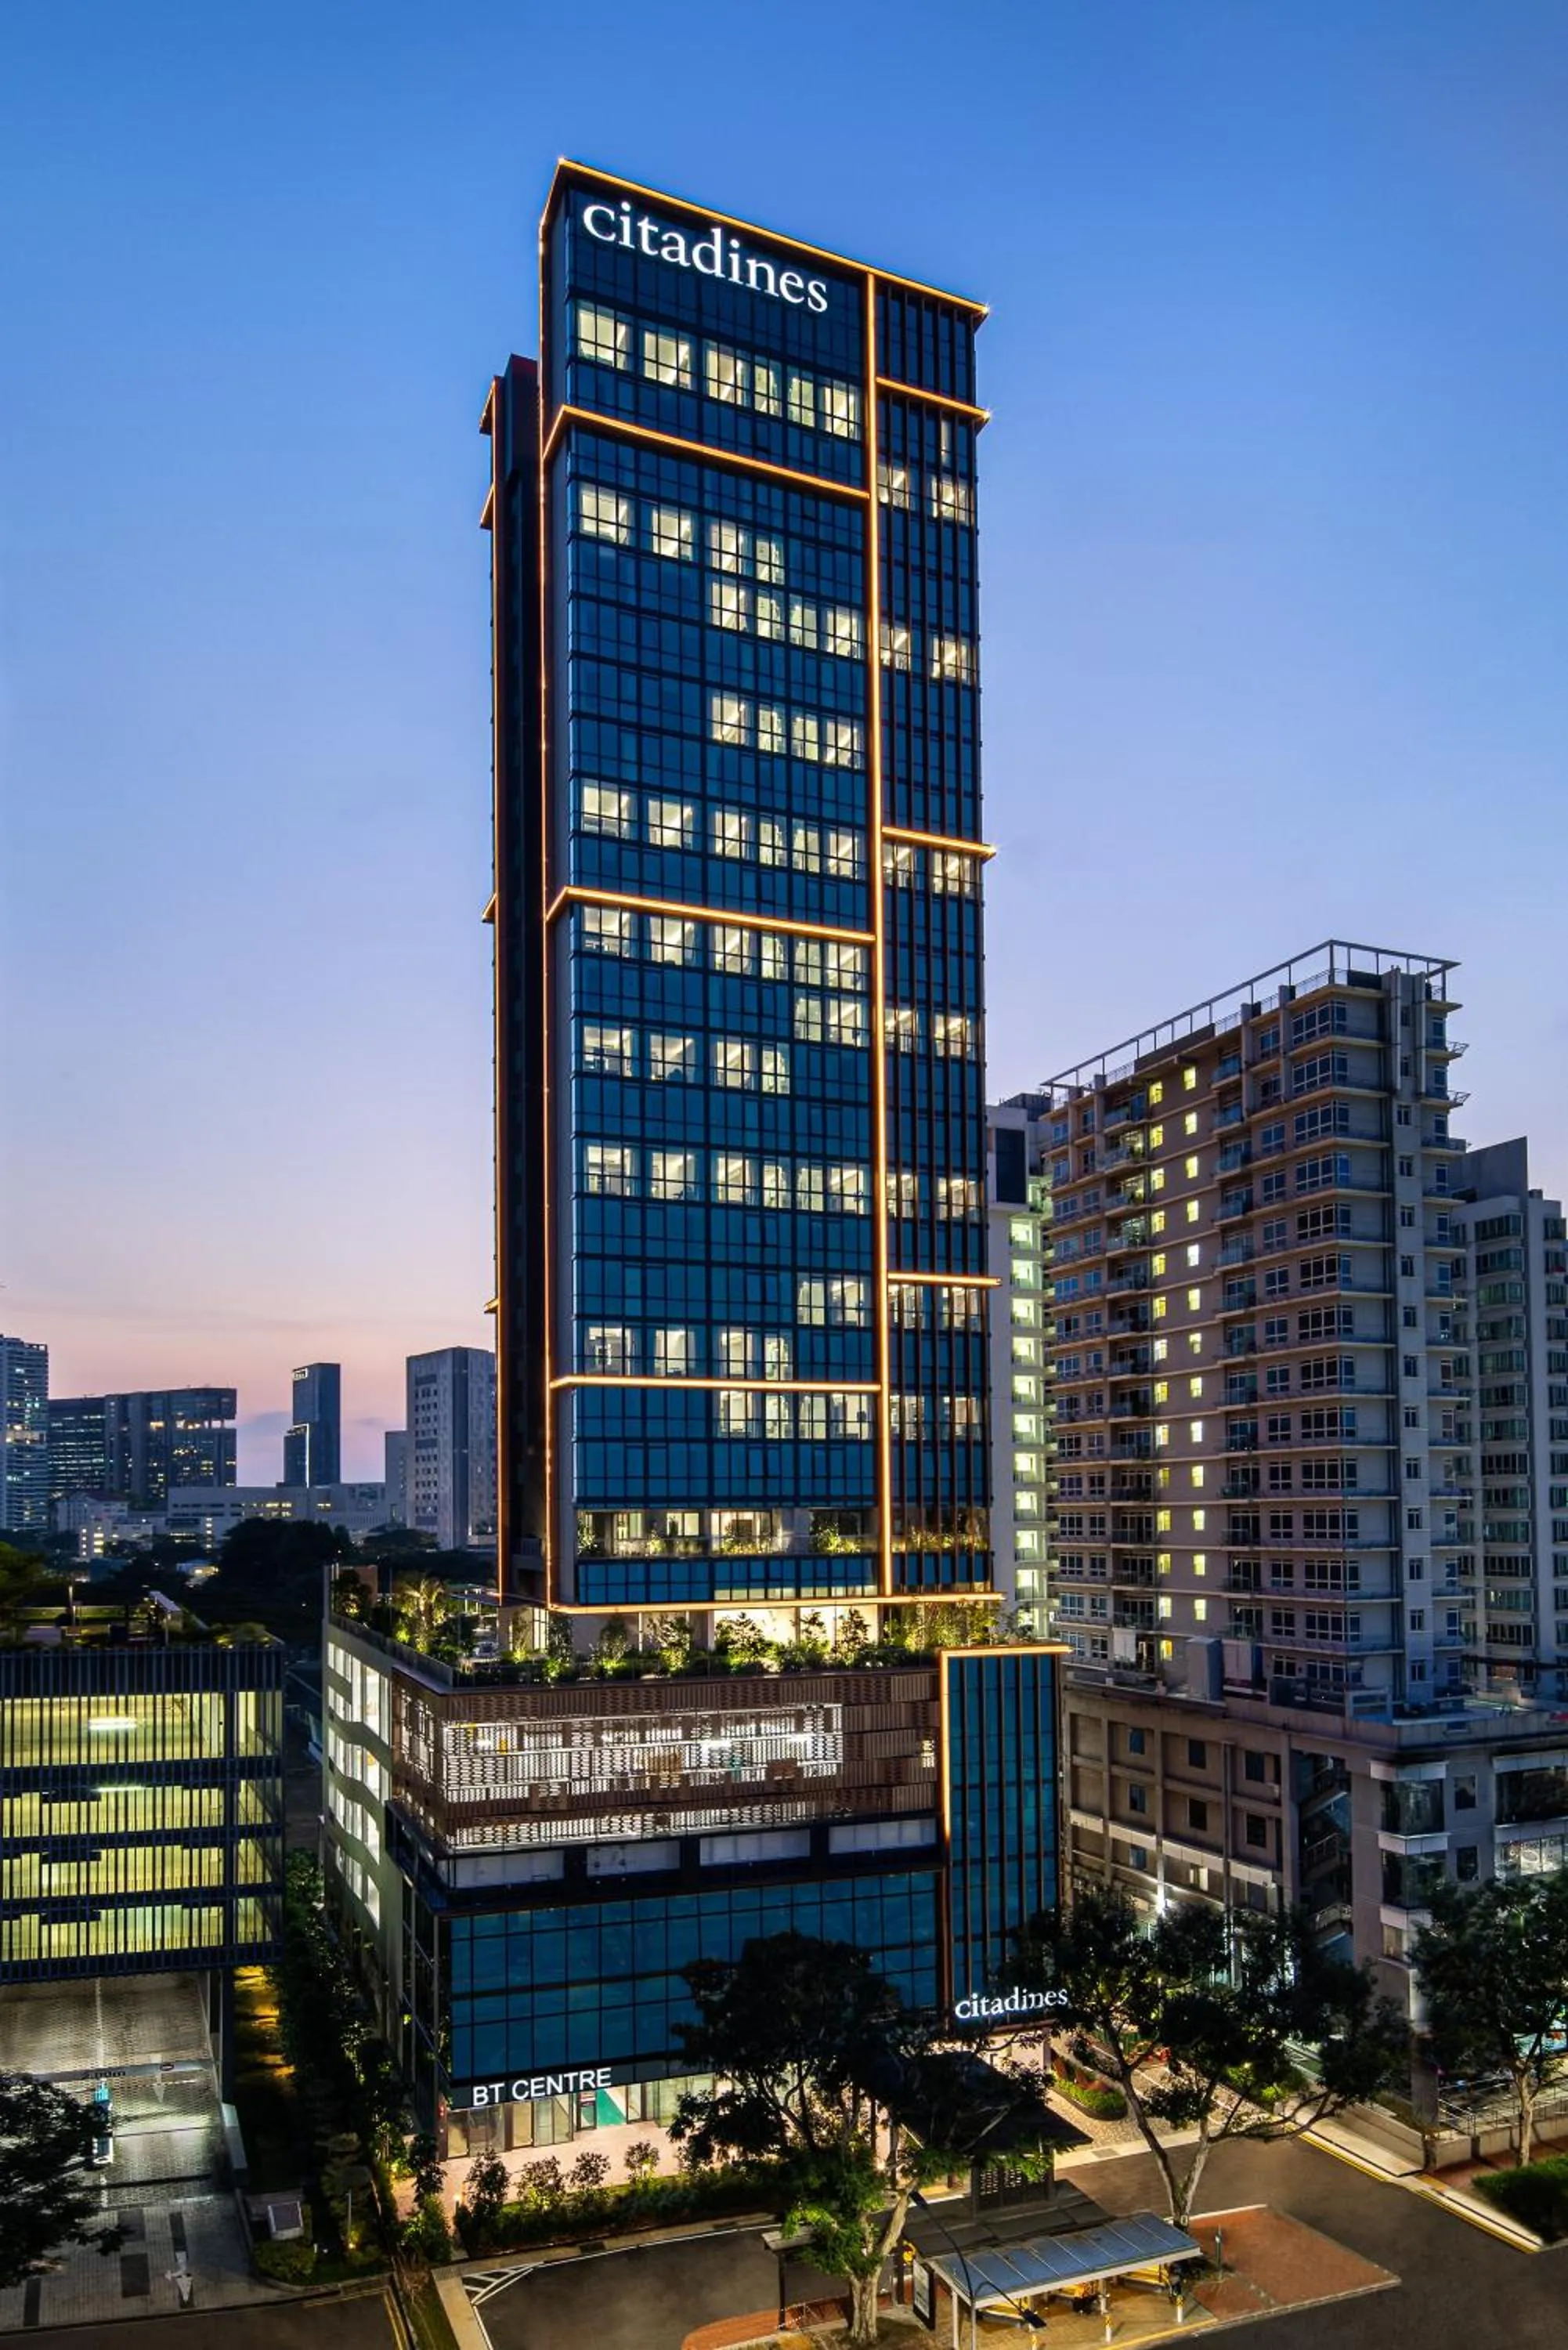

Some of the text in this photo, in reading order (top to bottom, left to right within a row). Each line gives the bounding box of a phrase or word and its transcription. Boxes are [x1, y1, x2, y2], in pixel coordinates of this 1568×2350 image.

[583, 201, 828, 313] citadines
[955, 1987, 1068, 2019] citadines
[472, 2067, 612, 2106] BT CENTRE
